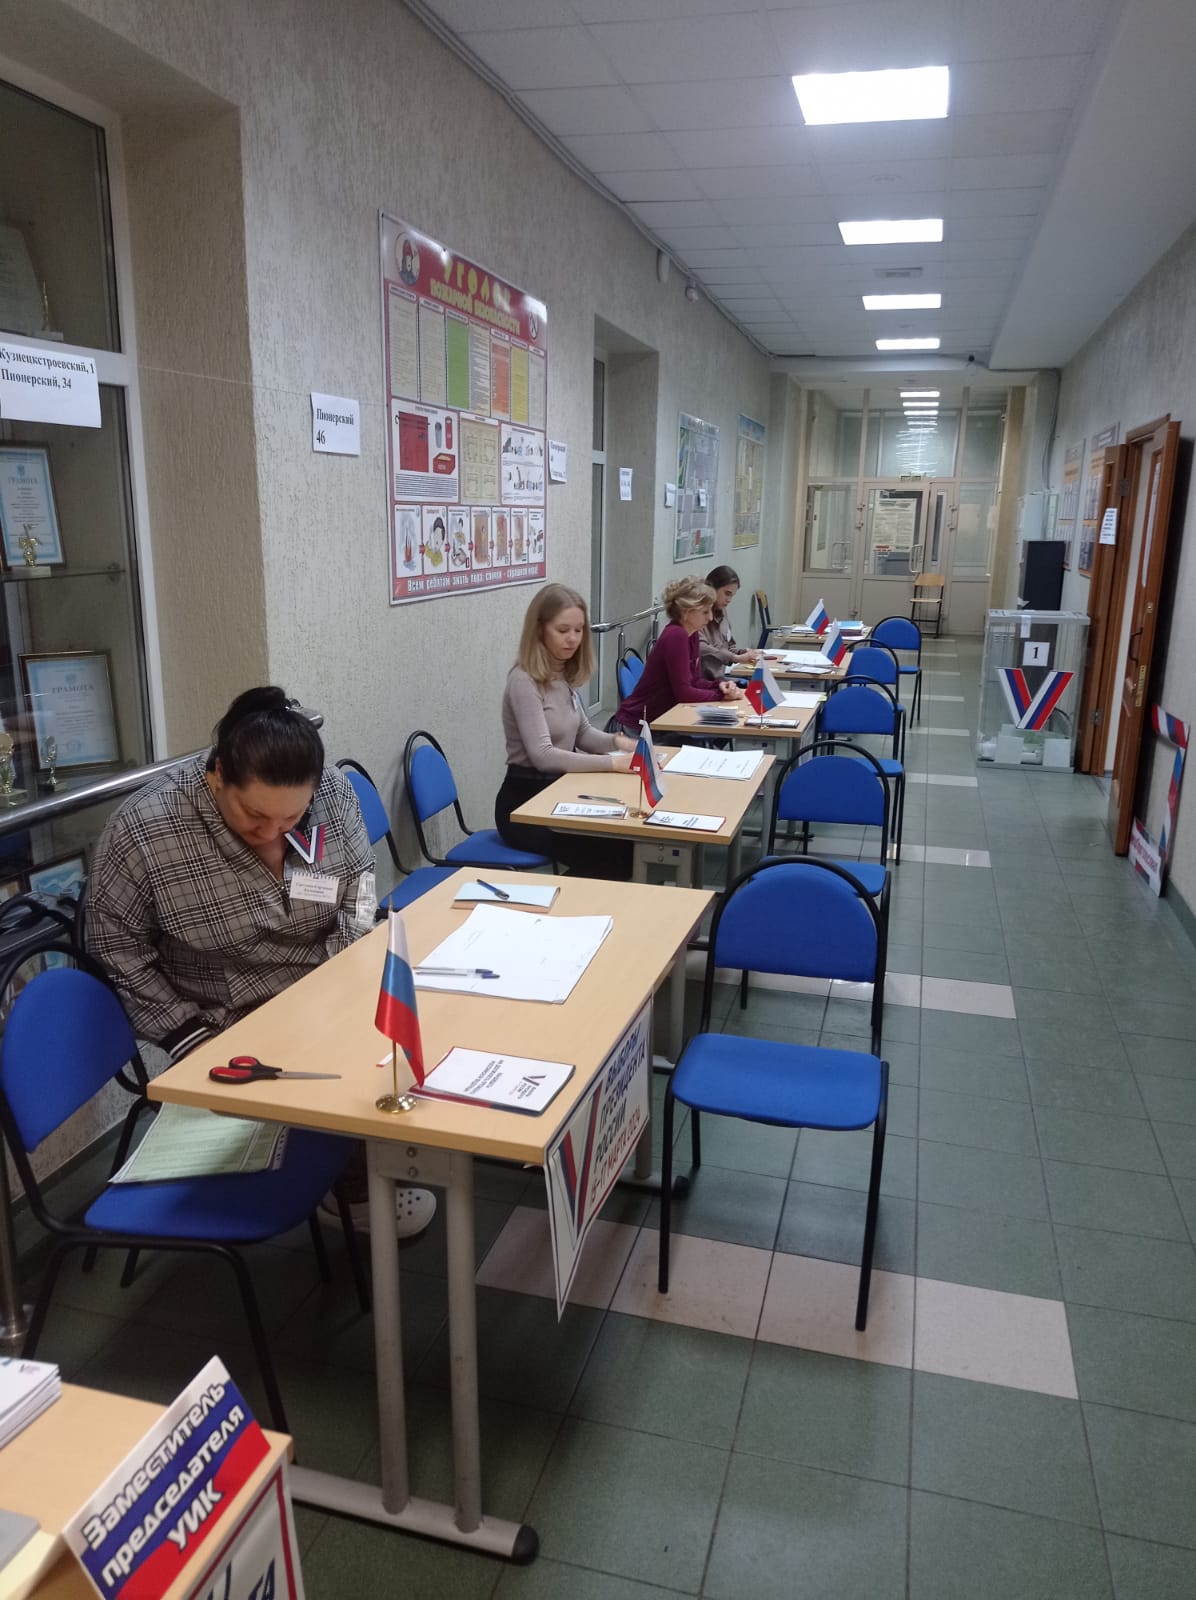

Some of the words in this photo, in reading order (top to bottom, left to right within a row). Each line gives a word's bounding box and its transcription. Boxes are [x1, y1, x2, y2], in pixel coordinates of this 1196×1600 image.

[0, 347, 89, 375] Кузнецкстроевский,
[90, 362, 95, 374] 1
[1, 368, 61, 390] Пионерский,
[62, 377, 72, 389] 34
[316, 408, 354, 426] Пионерский
[316, 430, 326, 445] 46
[1033, 646, 1039, 659] 1
[81, 1381, 226, 1551] Заместитель
[101, 1404, 245, 1588] председателя
[167, 1480, 222, 1551] УИК
